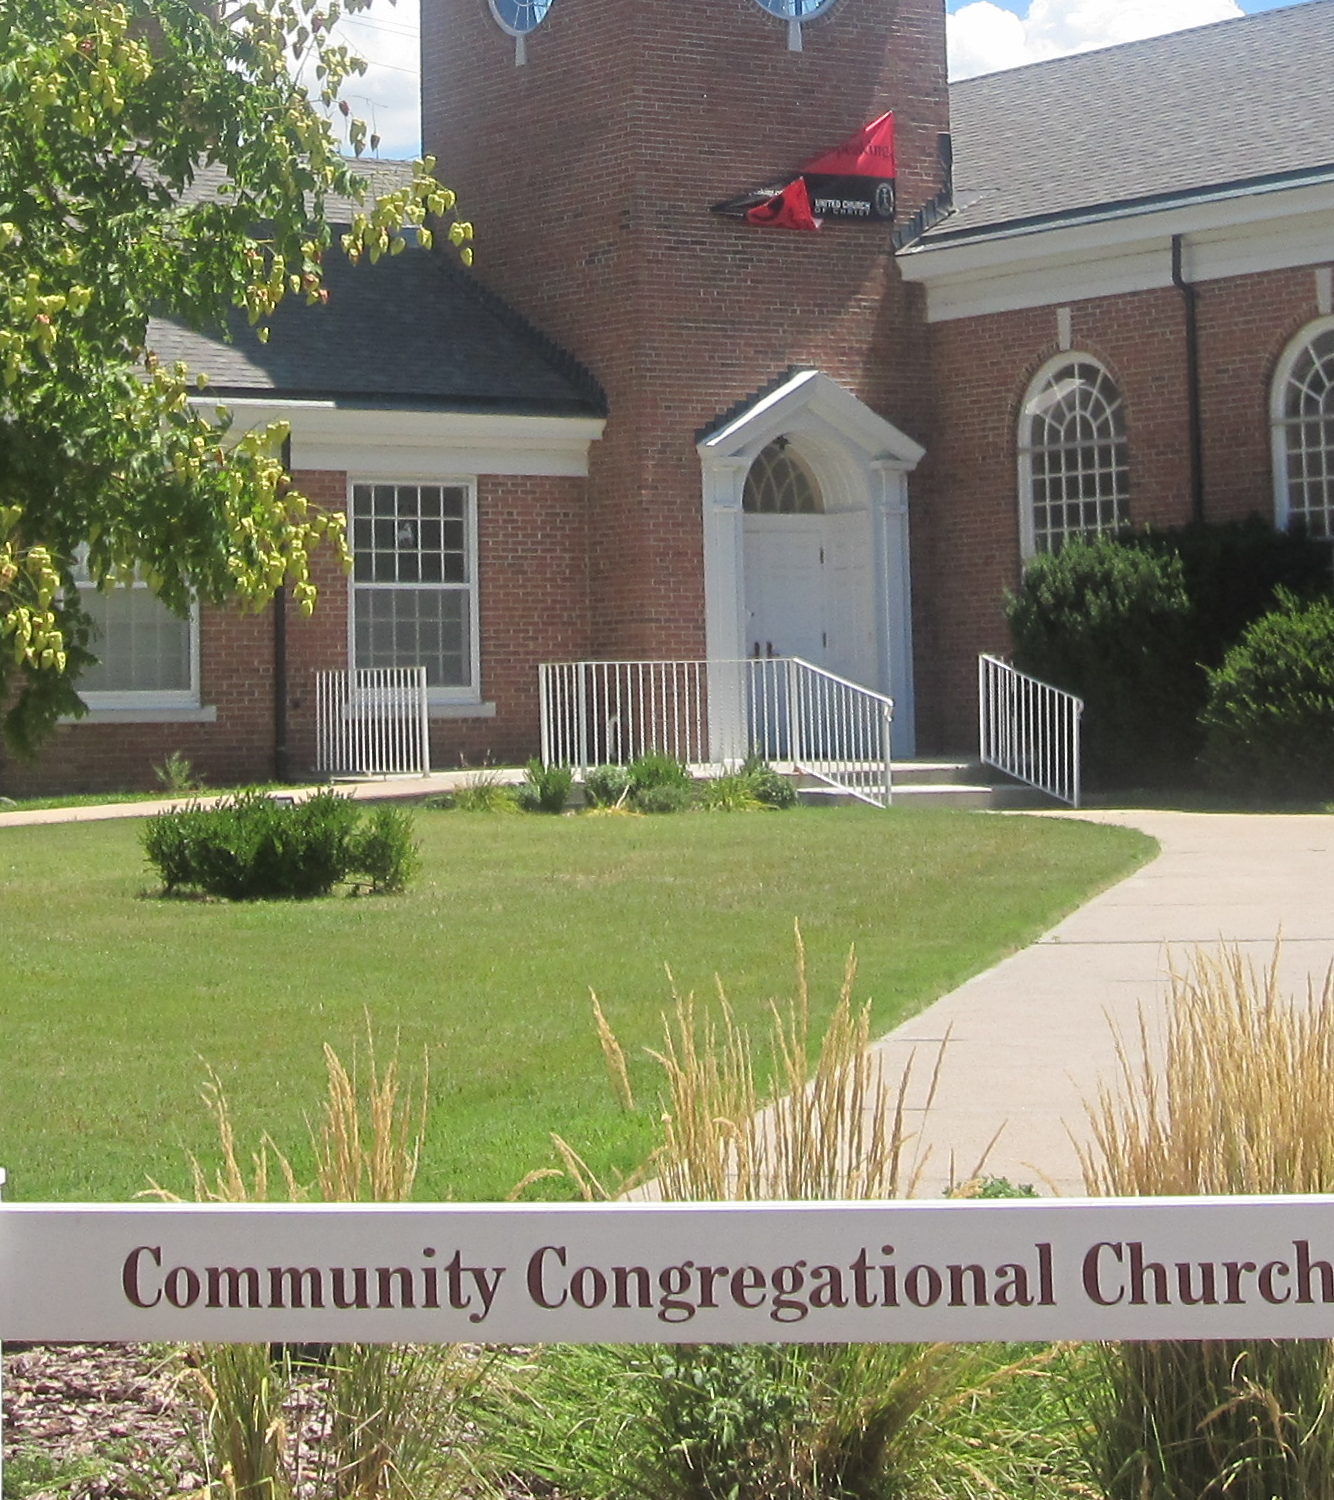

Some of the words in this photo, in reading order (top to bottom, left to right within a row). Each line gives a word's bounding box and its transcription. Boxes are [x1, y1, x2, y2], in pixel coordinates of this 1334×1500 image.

[814, 198, 841, 208] UNITED
[842, 200, 871, 210] CHURCH
[832, 208, 870, 216] CHRIST
[122, 1246, 507, 1324] Community
[526, 1242, 1057, 1324] Congregational
